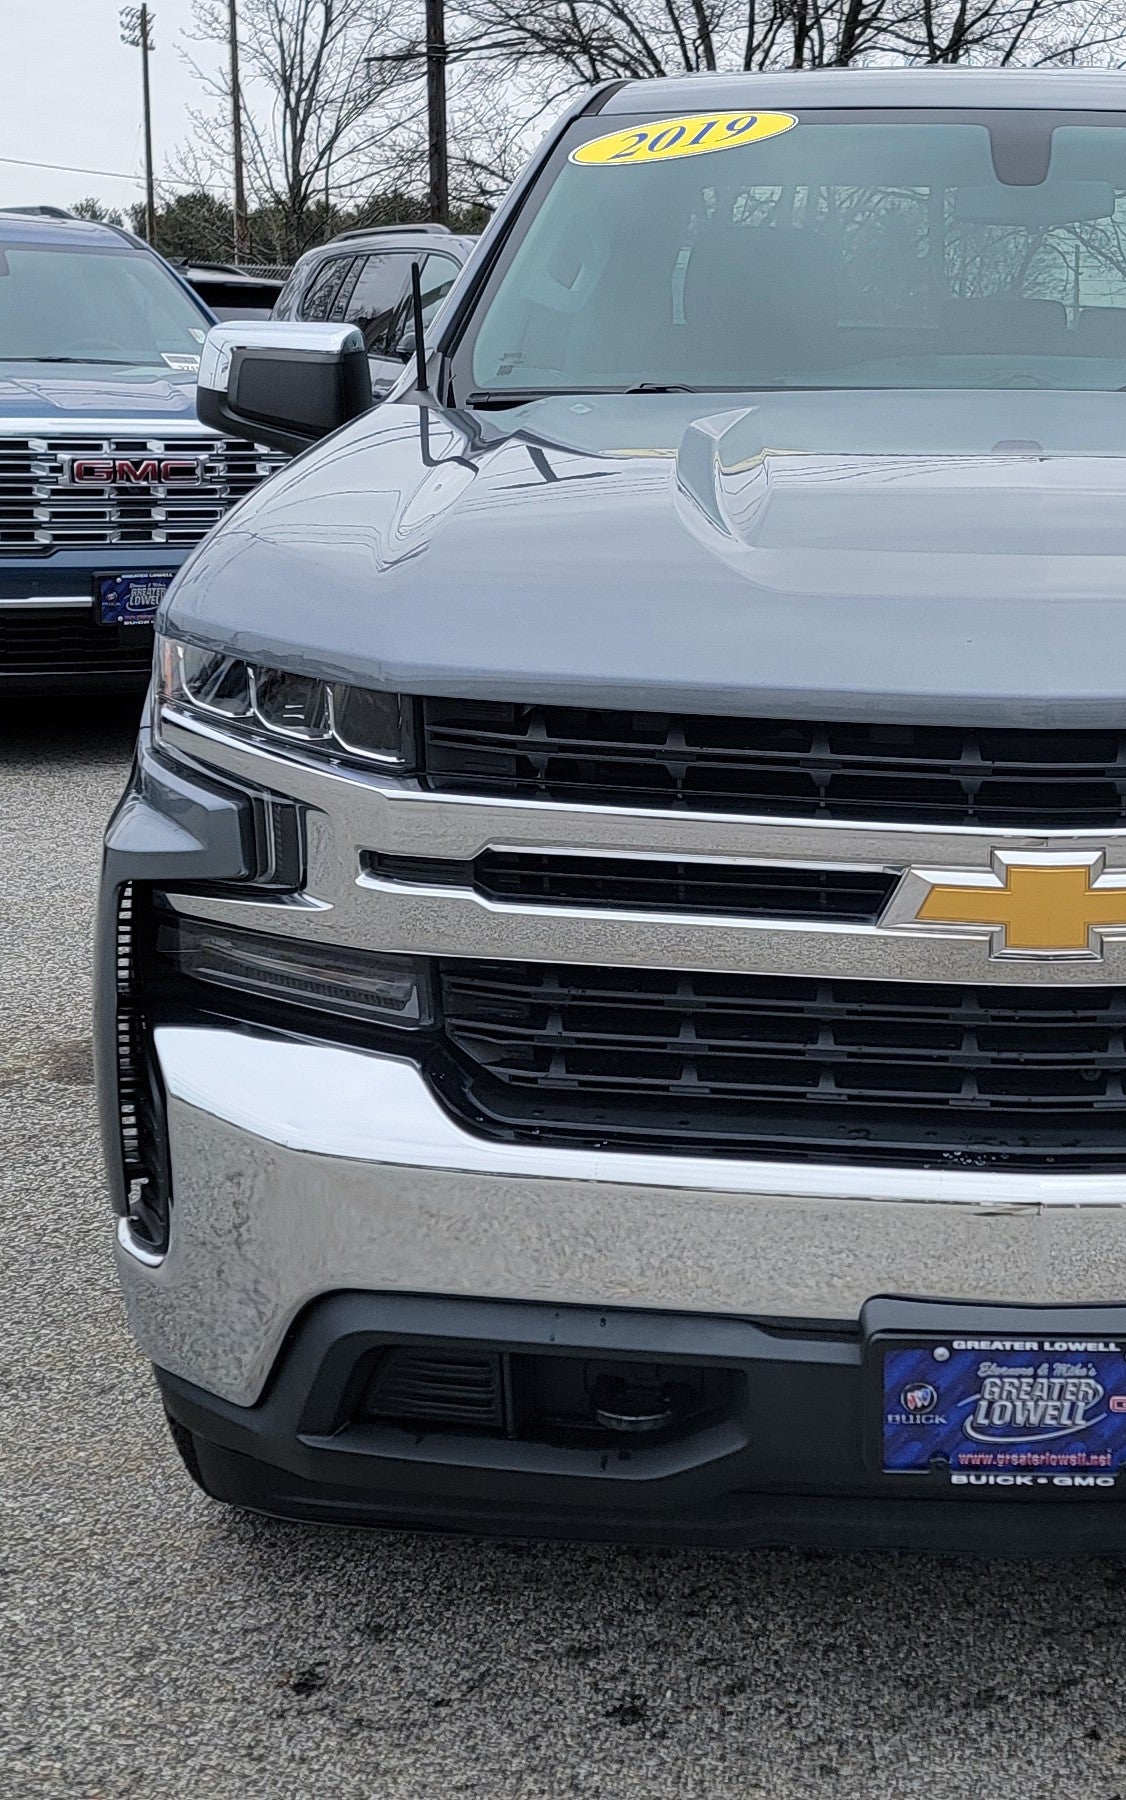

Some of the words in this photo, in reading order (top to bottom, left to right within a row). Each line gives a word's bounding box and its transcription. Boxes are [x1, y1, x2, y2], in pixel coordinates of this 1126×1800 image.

[606, 115, 758, 161] 2019
[73, 459, 199, 485] GMC
[129, 596, 162, 606] LOWEL
[952, 1340, 1039, 1352] GREATER
[1043, 1341, 1122, 1353] LOWELL
[980, 1378, 1097, 1401] GREATER
[887, 1413, 948, 1425] BUICK
[973, 1400, 1090, 1428] LOWELL
[951, 1474, 1034, 1486] BUICK
[1052, 1475, 1116, 1488] GMC
